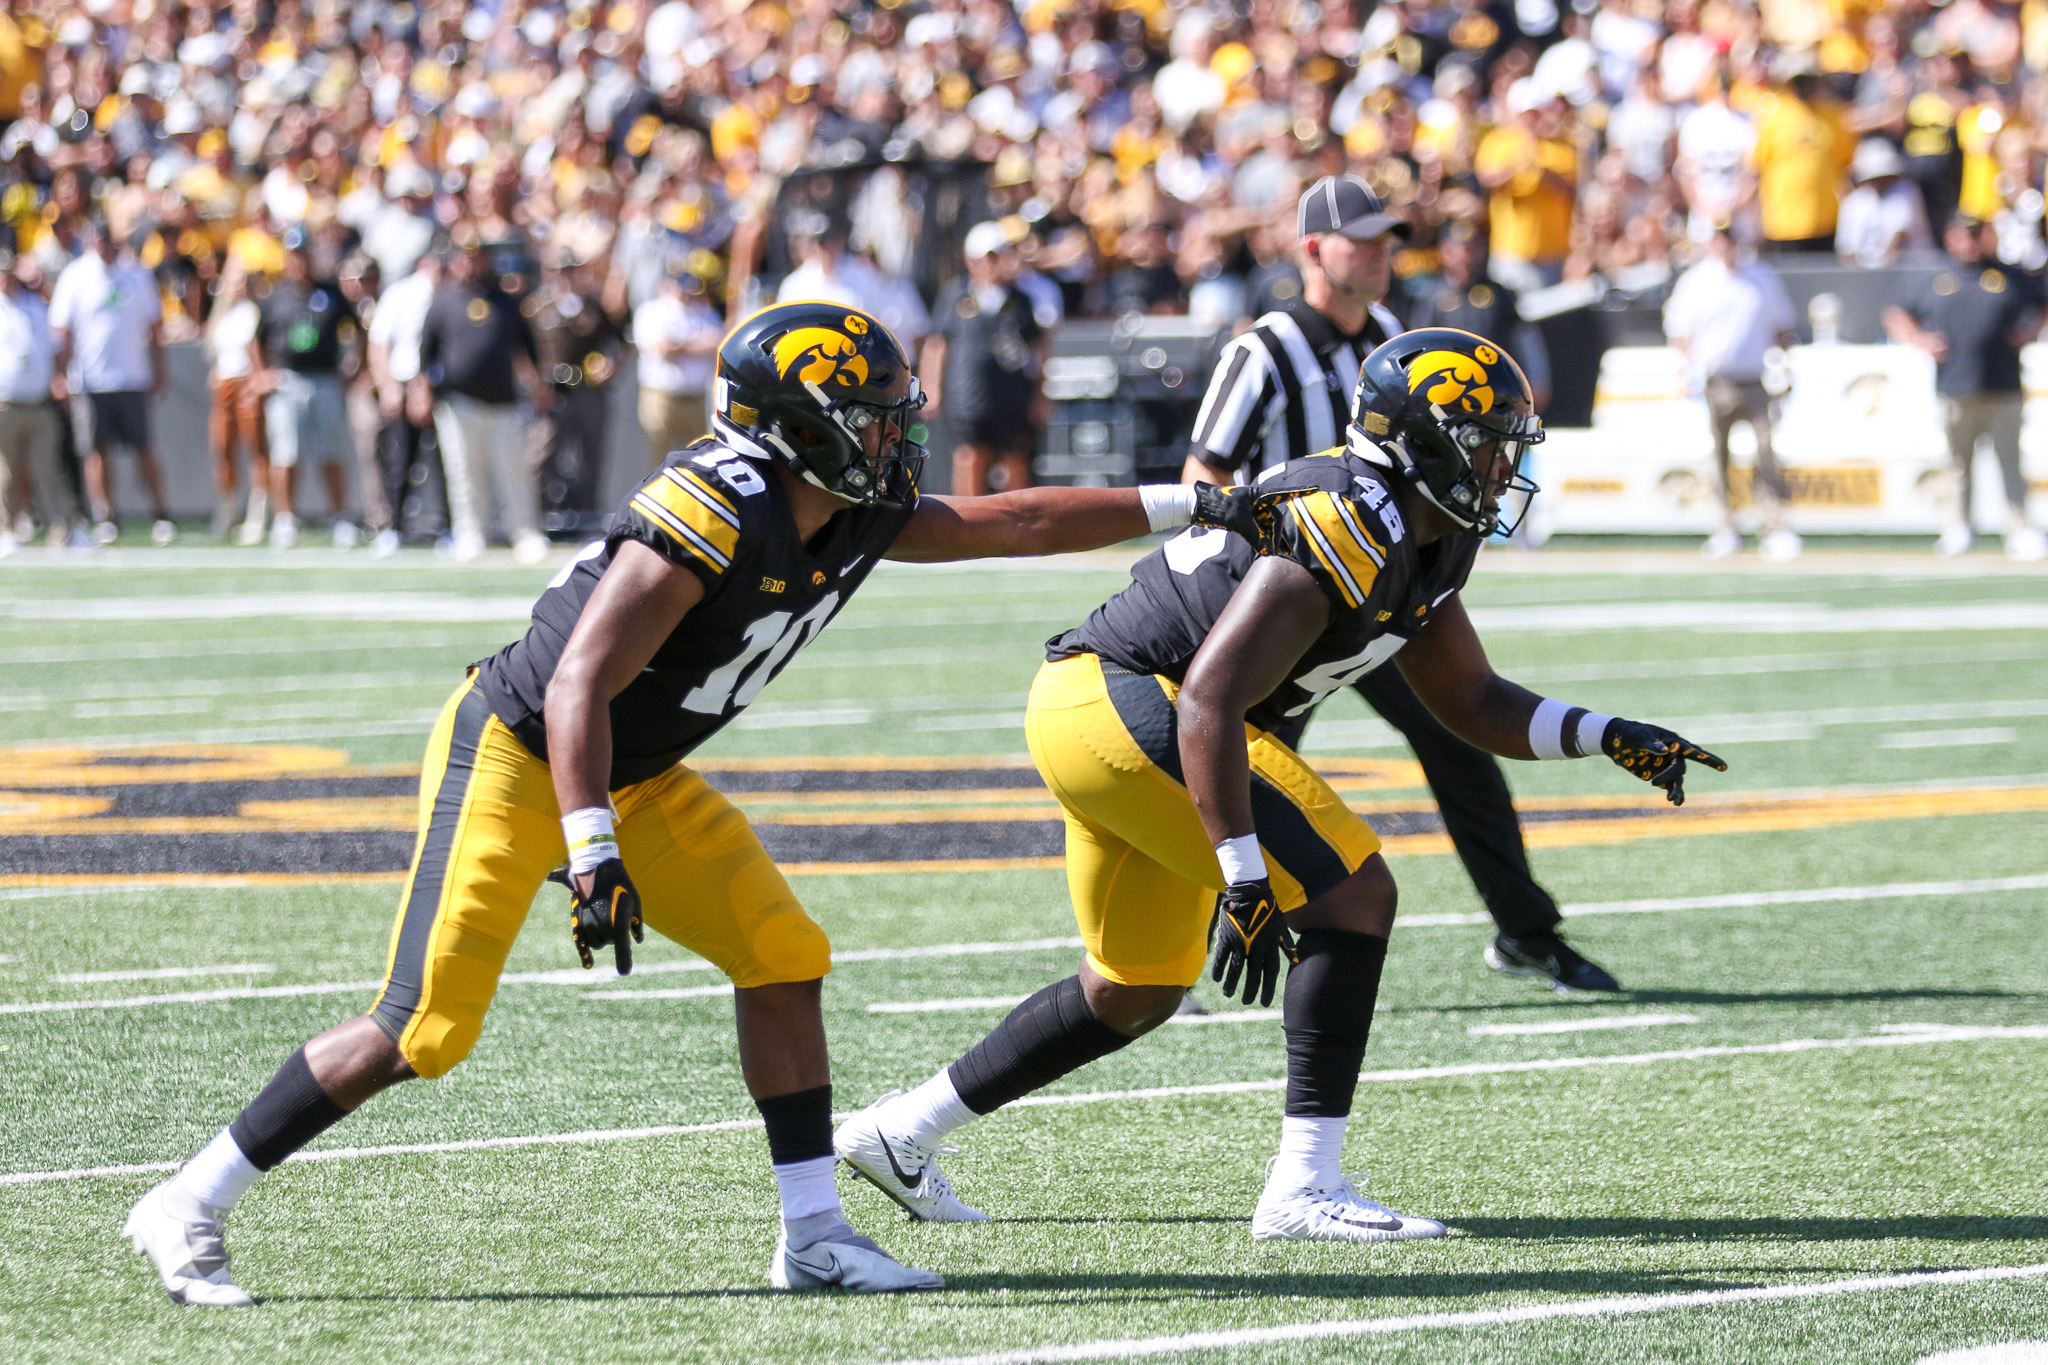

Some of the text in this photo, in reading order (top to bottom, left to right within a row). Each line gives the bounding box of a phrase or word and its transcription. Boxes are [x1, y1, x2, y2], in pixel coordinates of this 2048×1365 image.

[691, 447, 766, 497] 10
[1353, 475, 1406, 544] 45
[681, 590, 840, 715] 10
